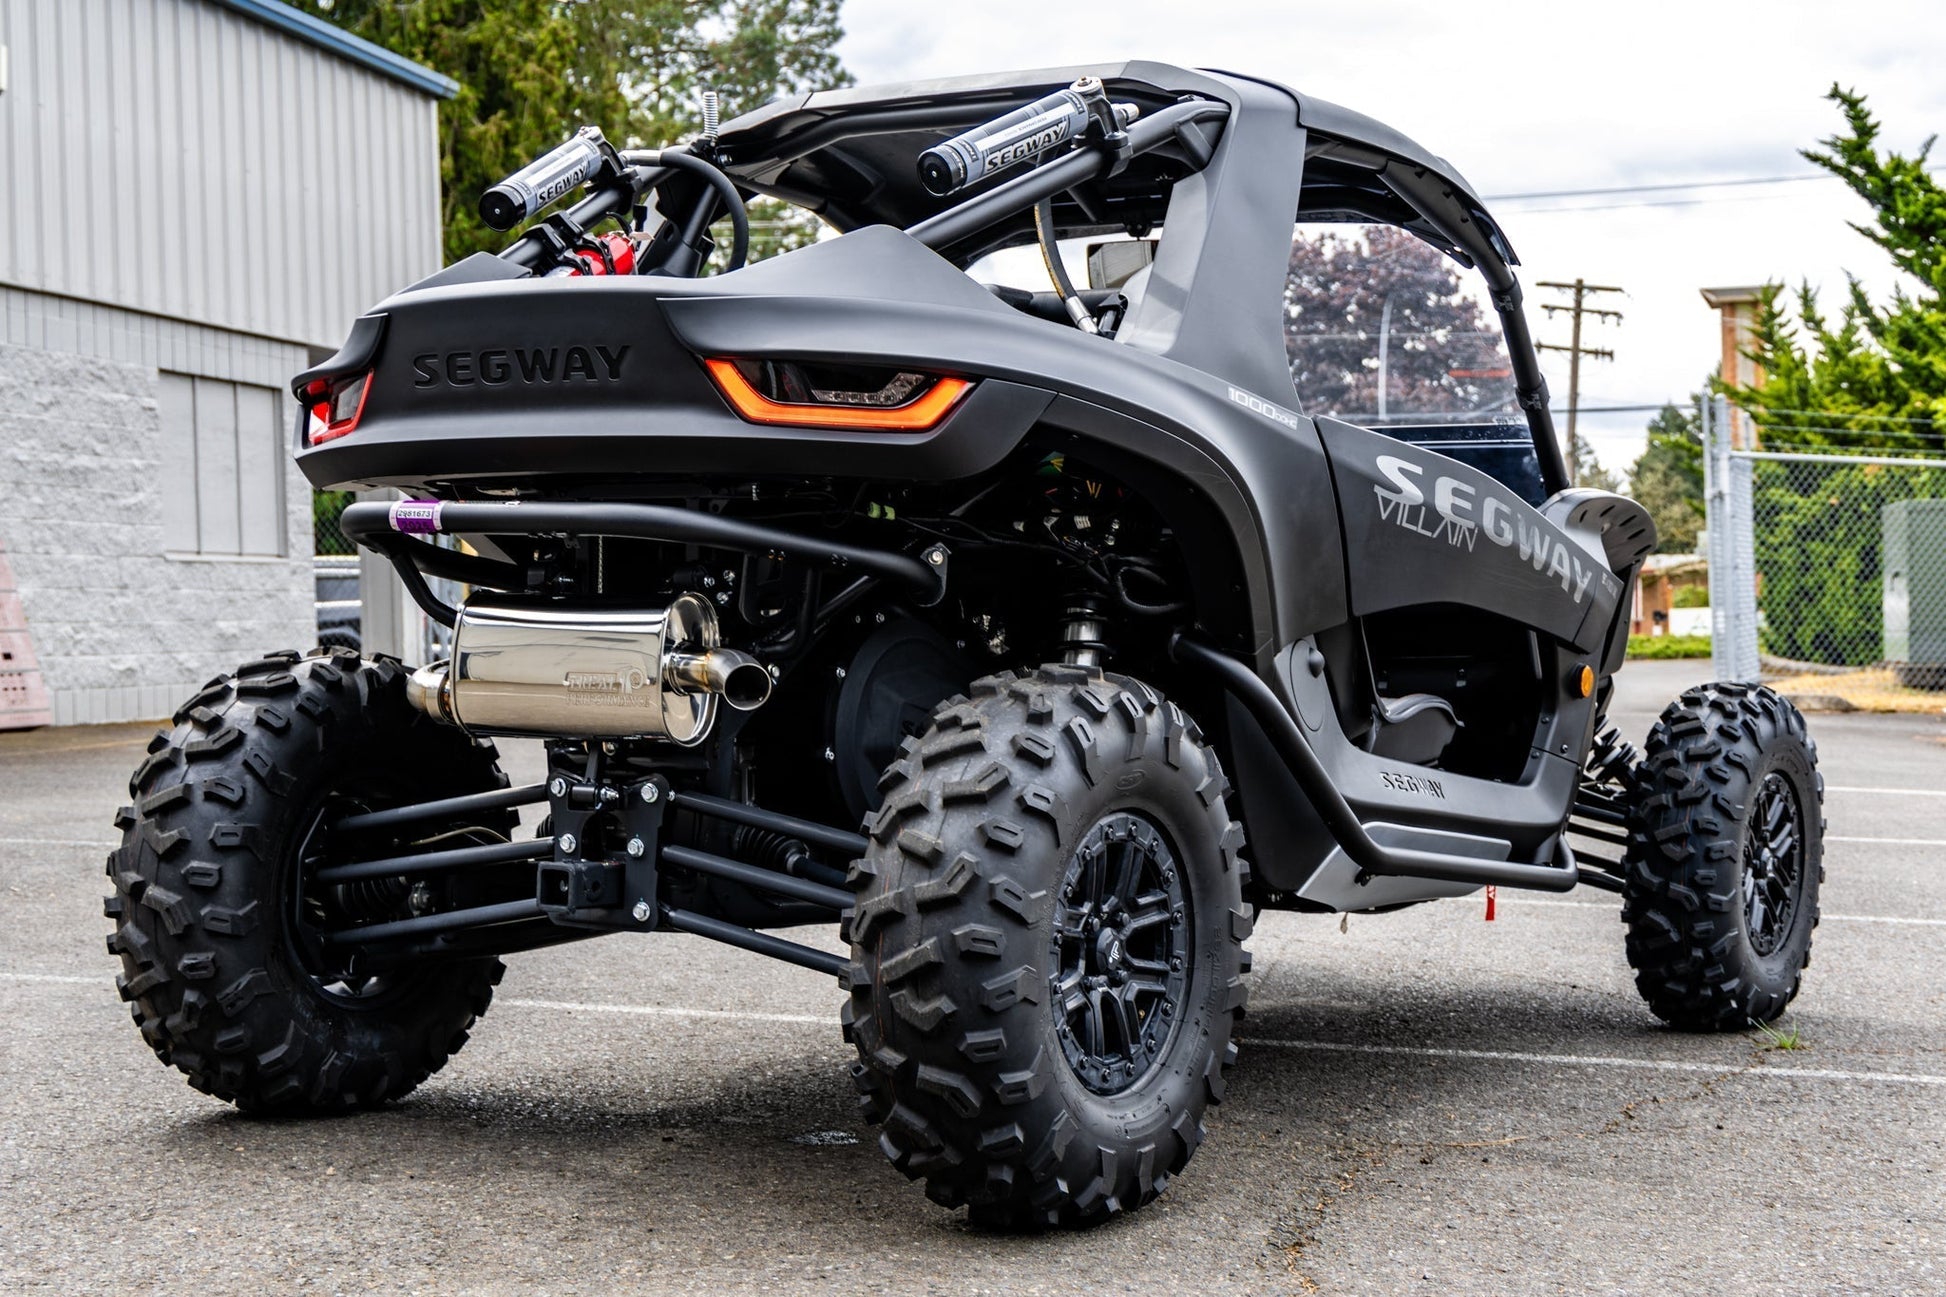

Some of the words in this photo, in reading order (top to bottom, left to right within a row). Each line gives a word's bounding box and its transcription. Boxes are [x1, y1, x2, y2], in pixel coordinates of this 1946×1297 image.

[987, 124, 1065, 171] SEGWAY
[538, 162, 587, 201] SEGWAY
[413, 345, 631, 389] SEGWAY
[1376, 455, 1592, 604] SEGWAY
[1380, 772, 1445, 799] SEGWAY
